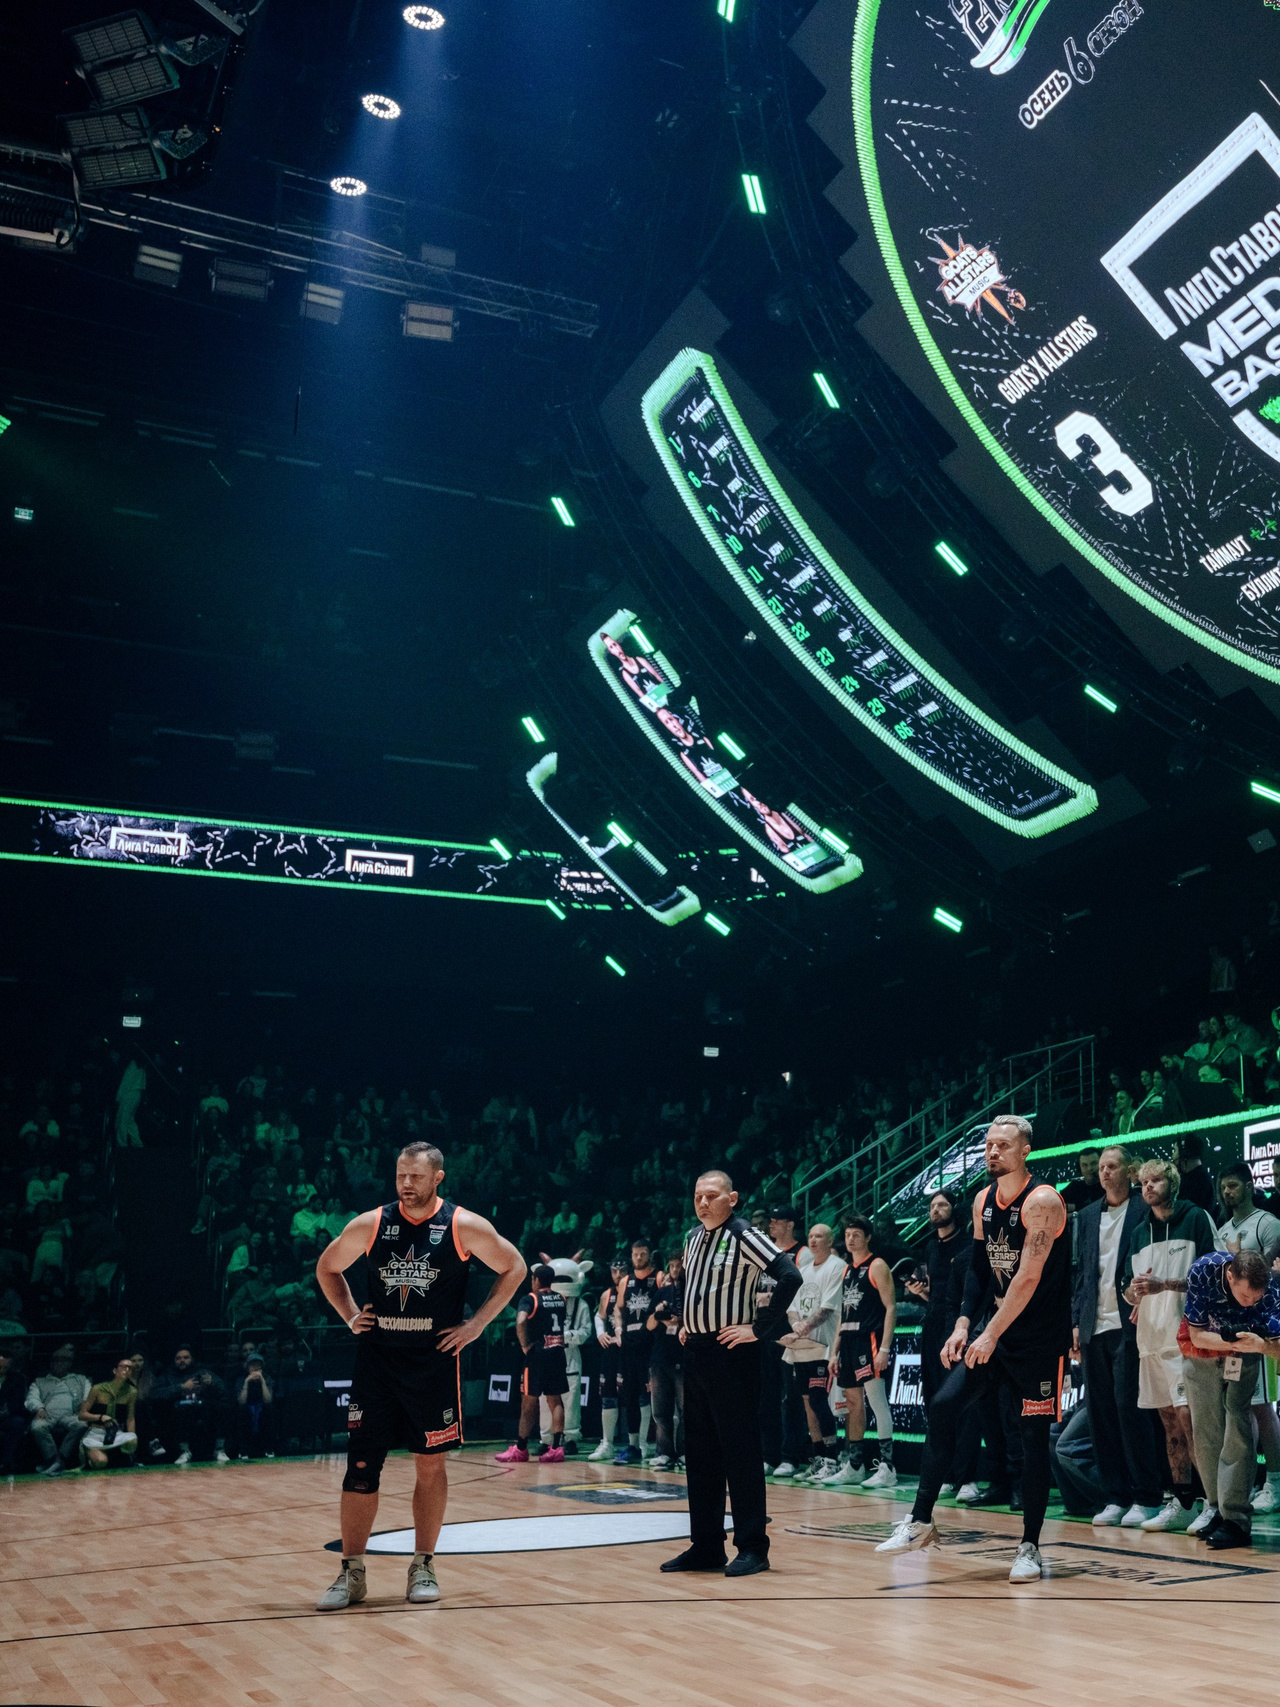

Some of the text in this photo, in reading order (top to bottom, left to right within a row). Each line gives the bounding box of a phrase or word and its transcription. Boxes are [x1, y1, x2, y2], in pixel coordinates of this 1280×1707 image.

[1020, 72, 1072, 128] ОСЕНЬ
[1064, 36, 1095, 84] 6
[941, 247, 978, 280] GOATS
[943, 252, 996, 300] ALLSTARS
[969, 275, 991, 296] MUSIC
[998, 315, 1098, 404] GOATS X ALLSTARS
[1054, 410, 1153, 516] 3
[687, 470, 702, 488] 6
[726, 534, 744, 555] 10
[1199, 534, 1251, 574] ТАЙМАУТ
[747, 565, 764, 584] 11
[767, 596, 785, 615] 21
[791, 621, 811, 641] 22
[816, 646, 835, 667] 23
[841, 674, 860, 693] 24
[867, 697, 886, 717] 29
[894, 720, 914, 740] 66
[385, 1225, 399, 1235] 10
[382, 1269, 436, 1279] ALLSTARS
[390, 1261, 427, 1270] GOATS
[552, 1313, 561, 1332] 1
